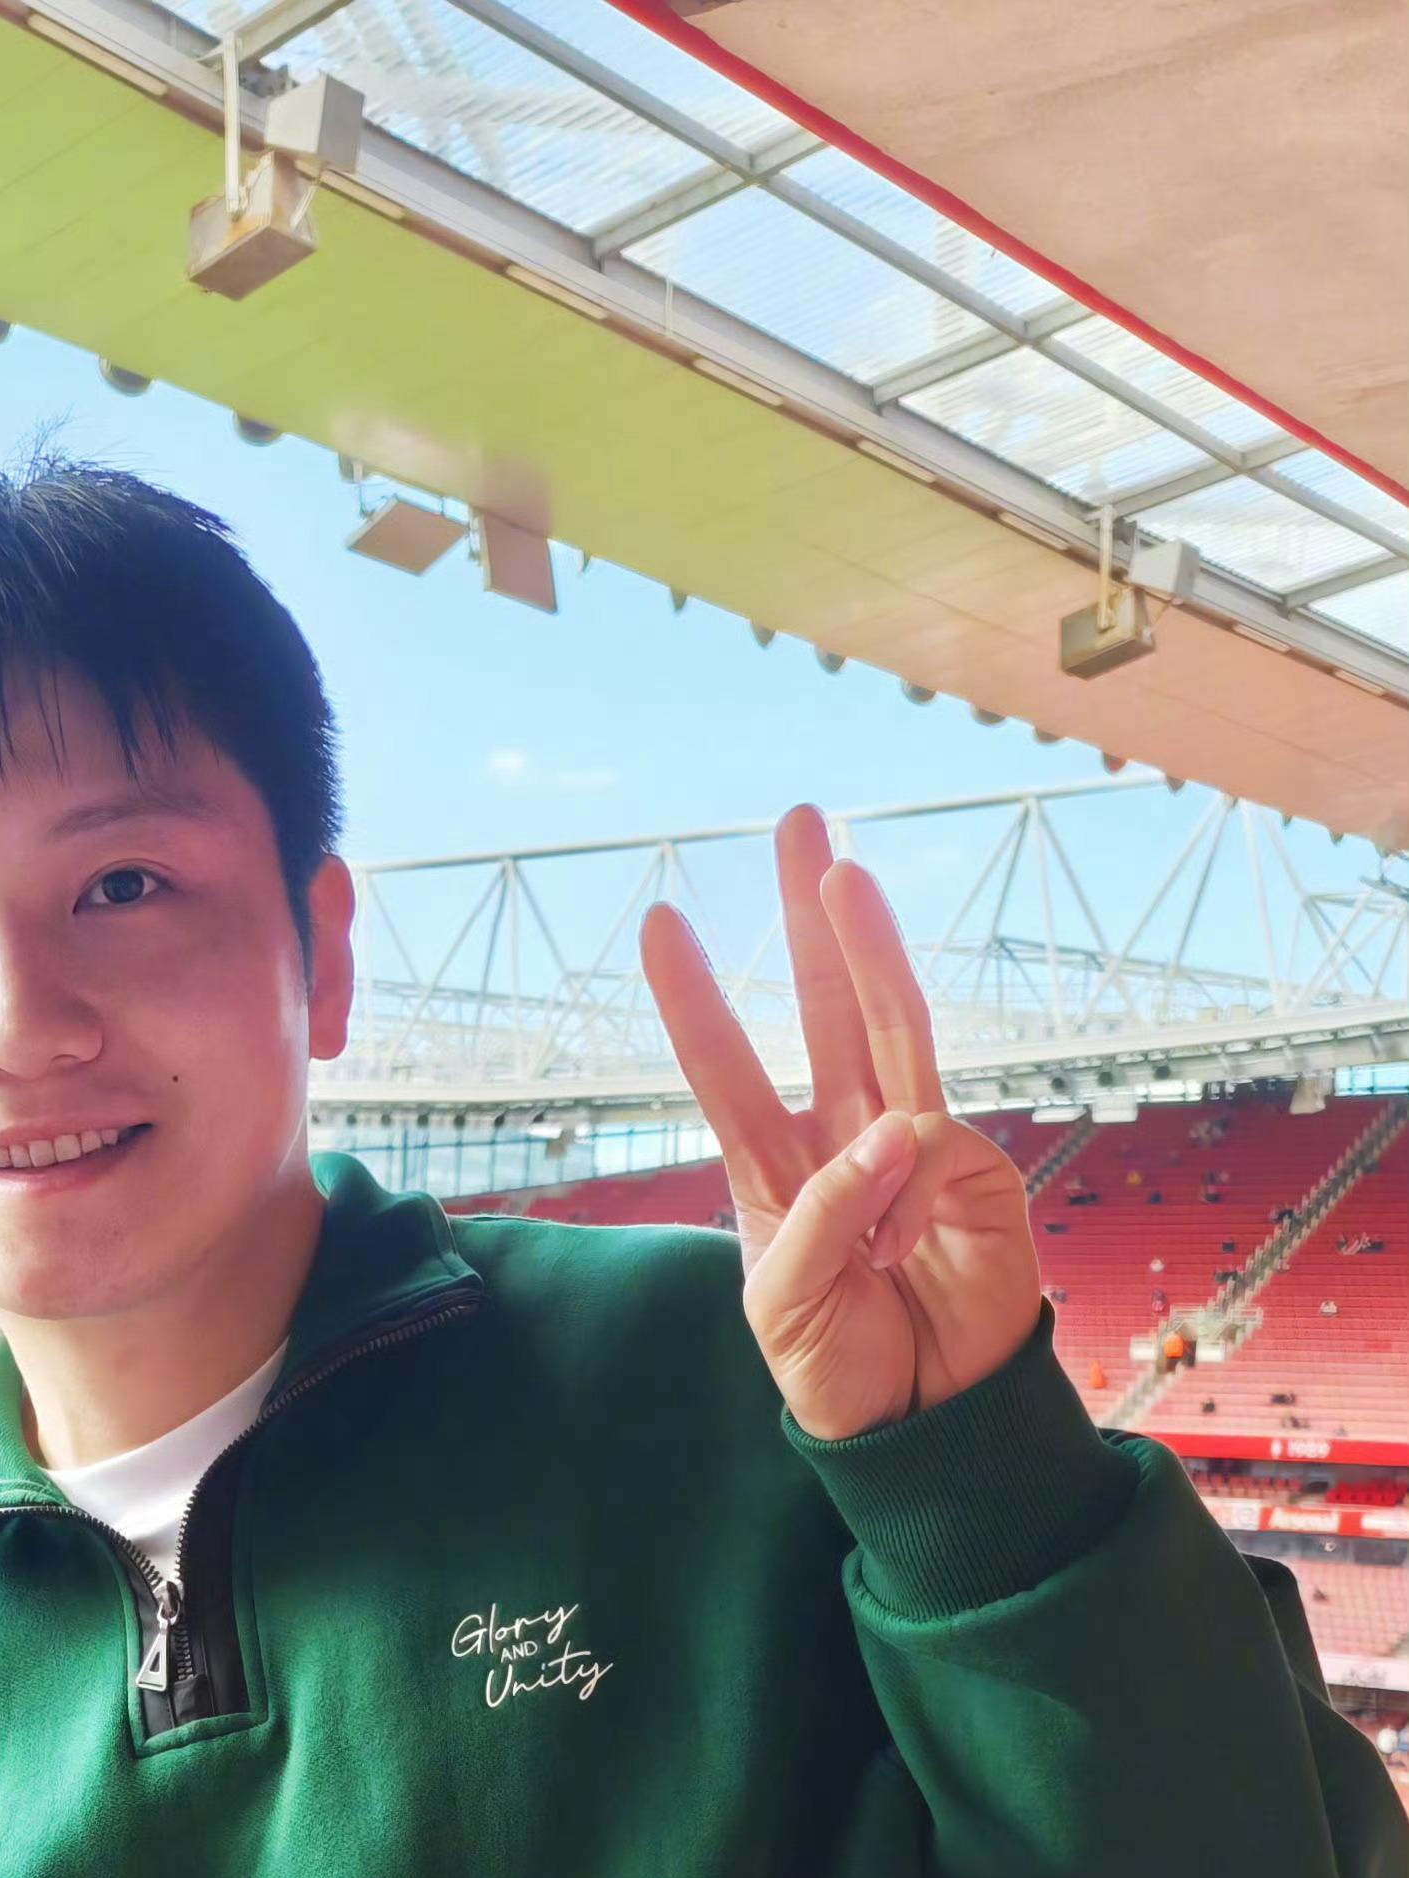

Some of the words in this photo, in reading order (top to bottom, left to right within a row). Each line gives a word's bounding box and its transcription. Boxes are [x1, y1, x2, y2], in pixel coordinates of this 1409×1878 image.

[451, 1602, 579, 1658] Glory
[500, 1640, 539, 1664] AND
[485, 1640, 614, 1708] Unity
